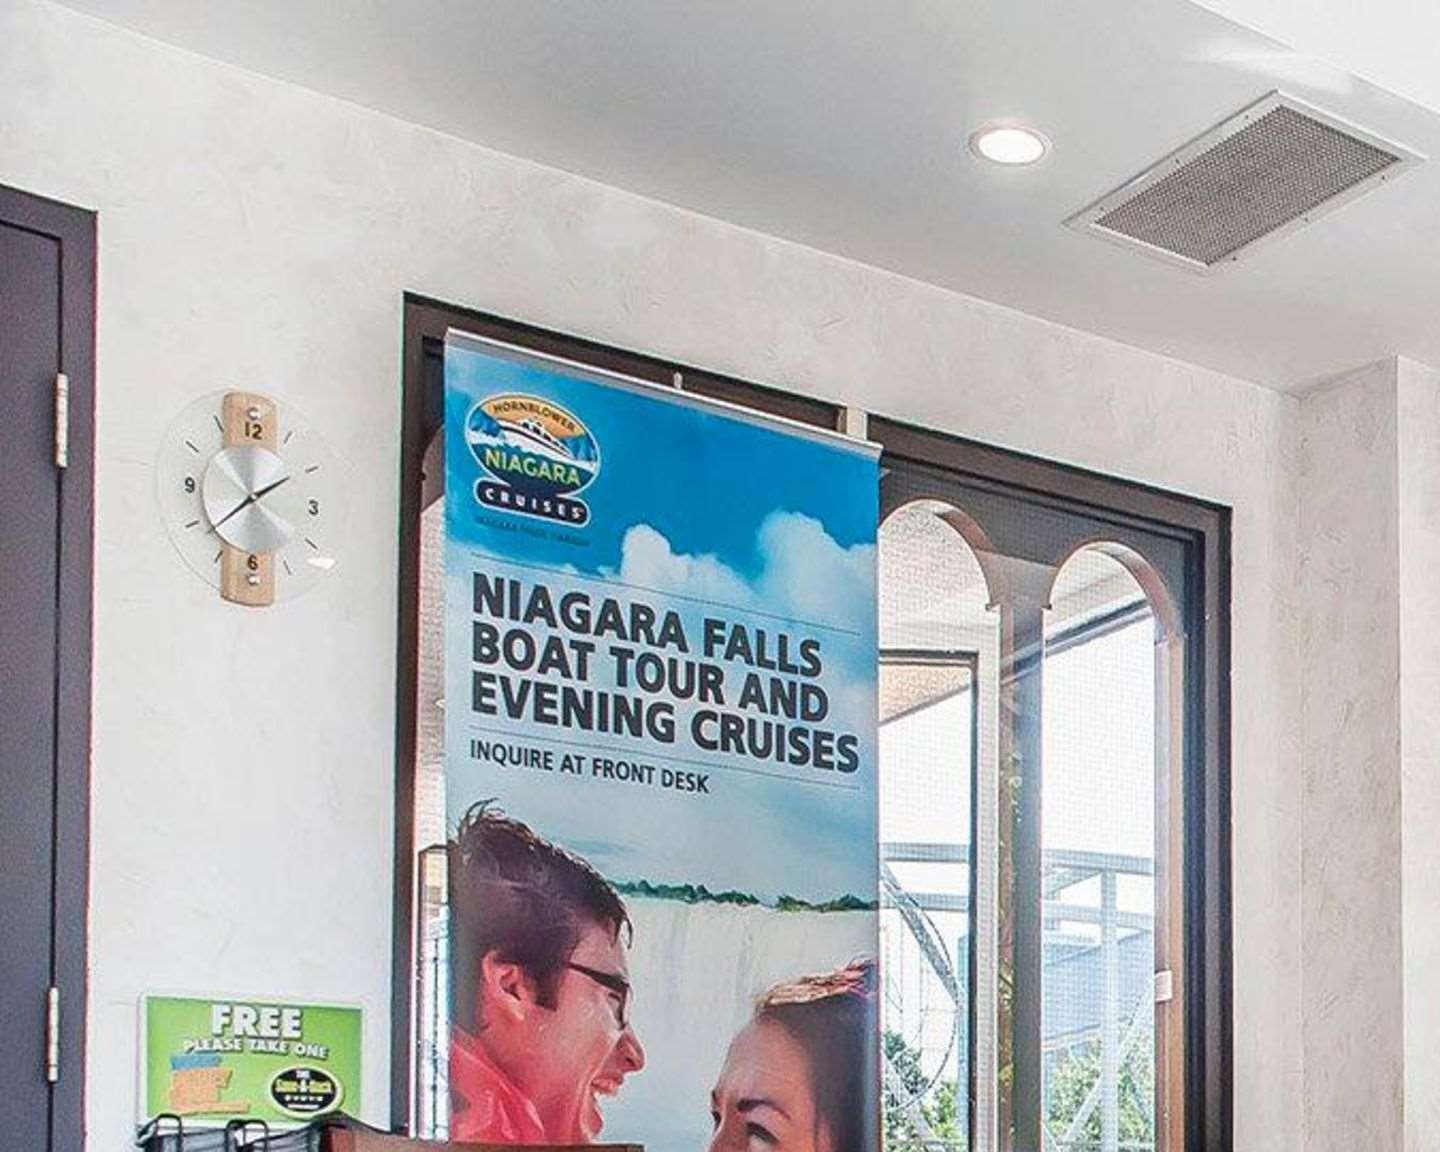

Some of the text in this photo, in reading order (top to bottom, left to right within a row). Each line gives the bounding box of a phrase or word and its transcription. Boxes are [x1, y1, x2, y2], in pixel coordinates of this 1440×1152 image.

[244, 421, 263, 440] 12
[493, 401, 576, 432] HORNBLOWER
[485, 448, 581, 487] NIAGARA
[184, 477, 195, 493] 9
[308, 499, 319, 515] 3
[485, 487, 581, 519] CRUISES
[247, 554, 258, 570] 6
[473, 571, 822, 678] NIAGARA FALLS
[472, 620, 829, 722] BOAT TOUR AND
[472, 670, 859, 773] EVENING CRUISES
[470, 739, 709, 794] INQUIRE AT FRONT DESK
[211, 1004, 302, 1039] FREE
[183, 1037, 329, 1060] PLEASE TAKE ONE
